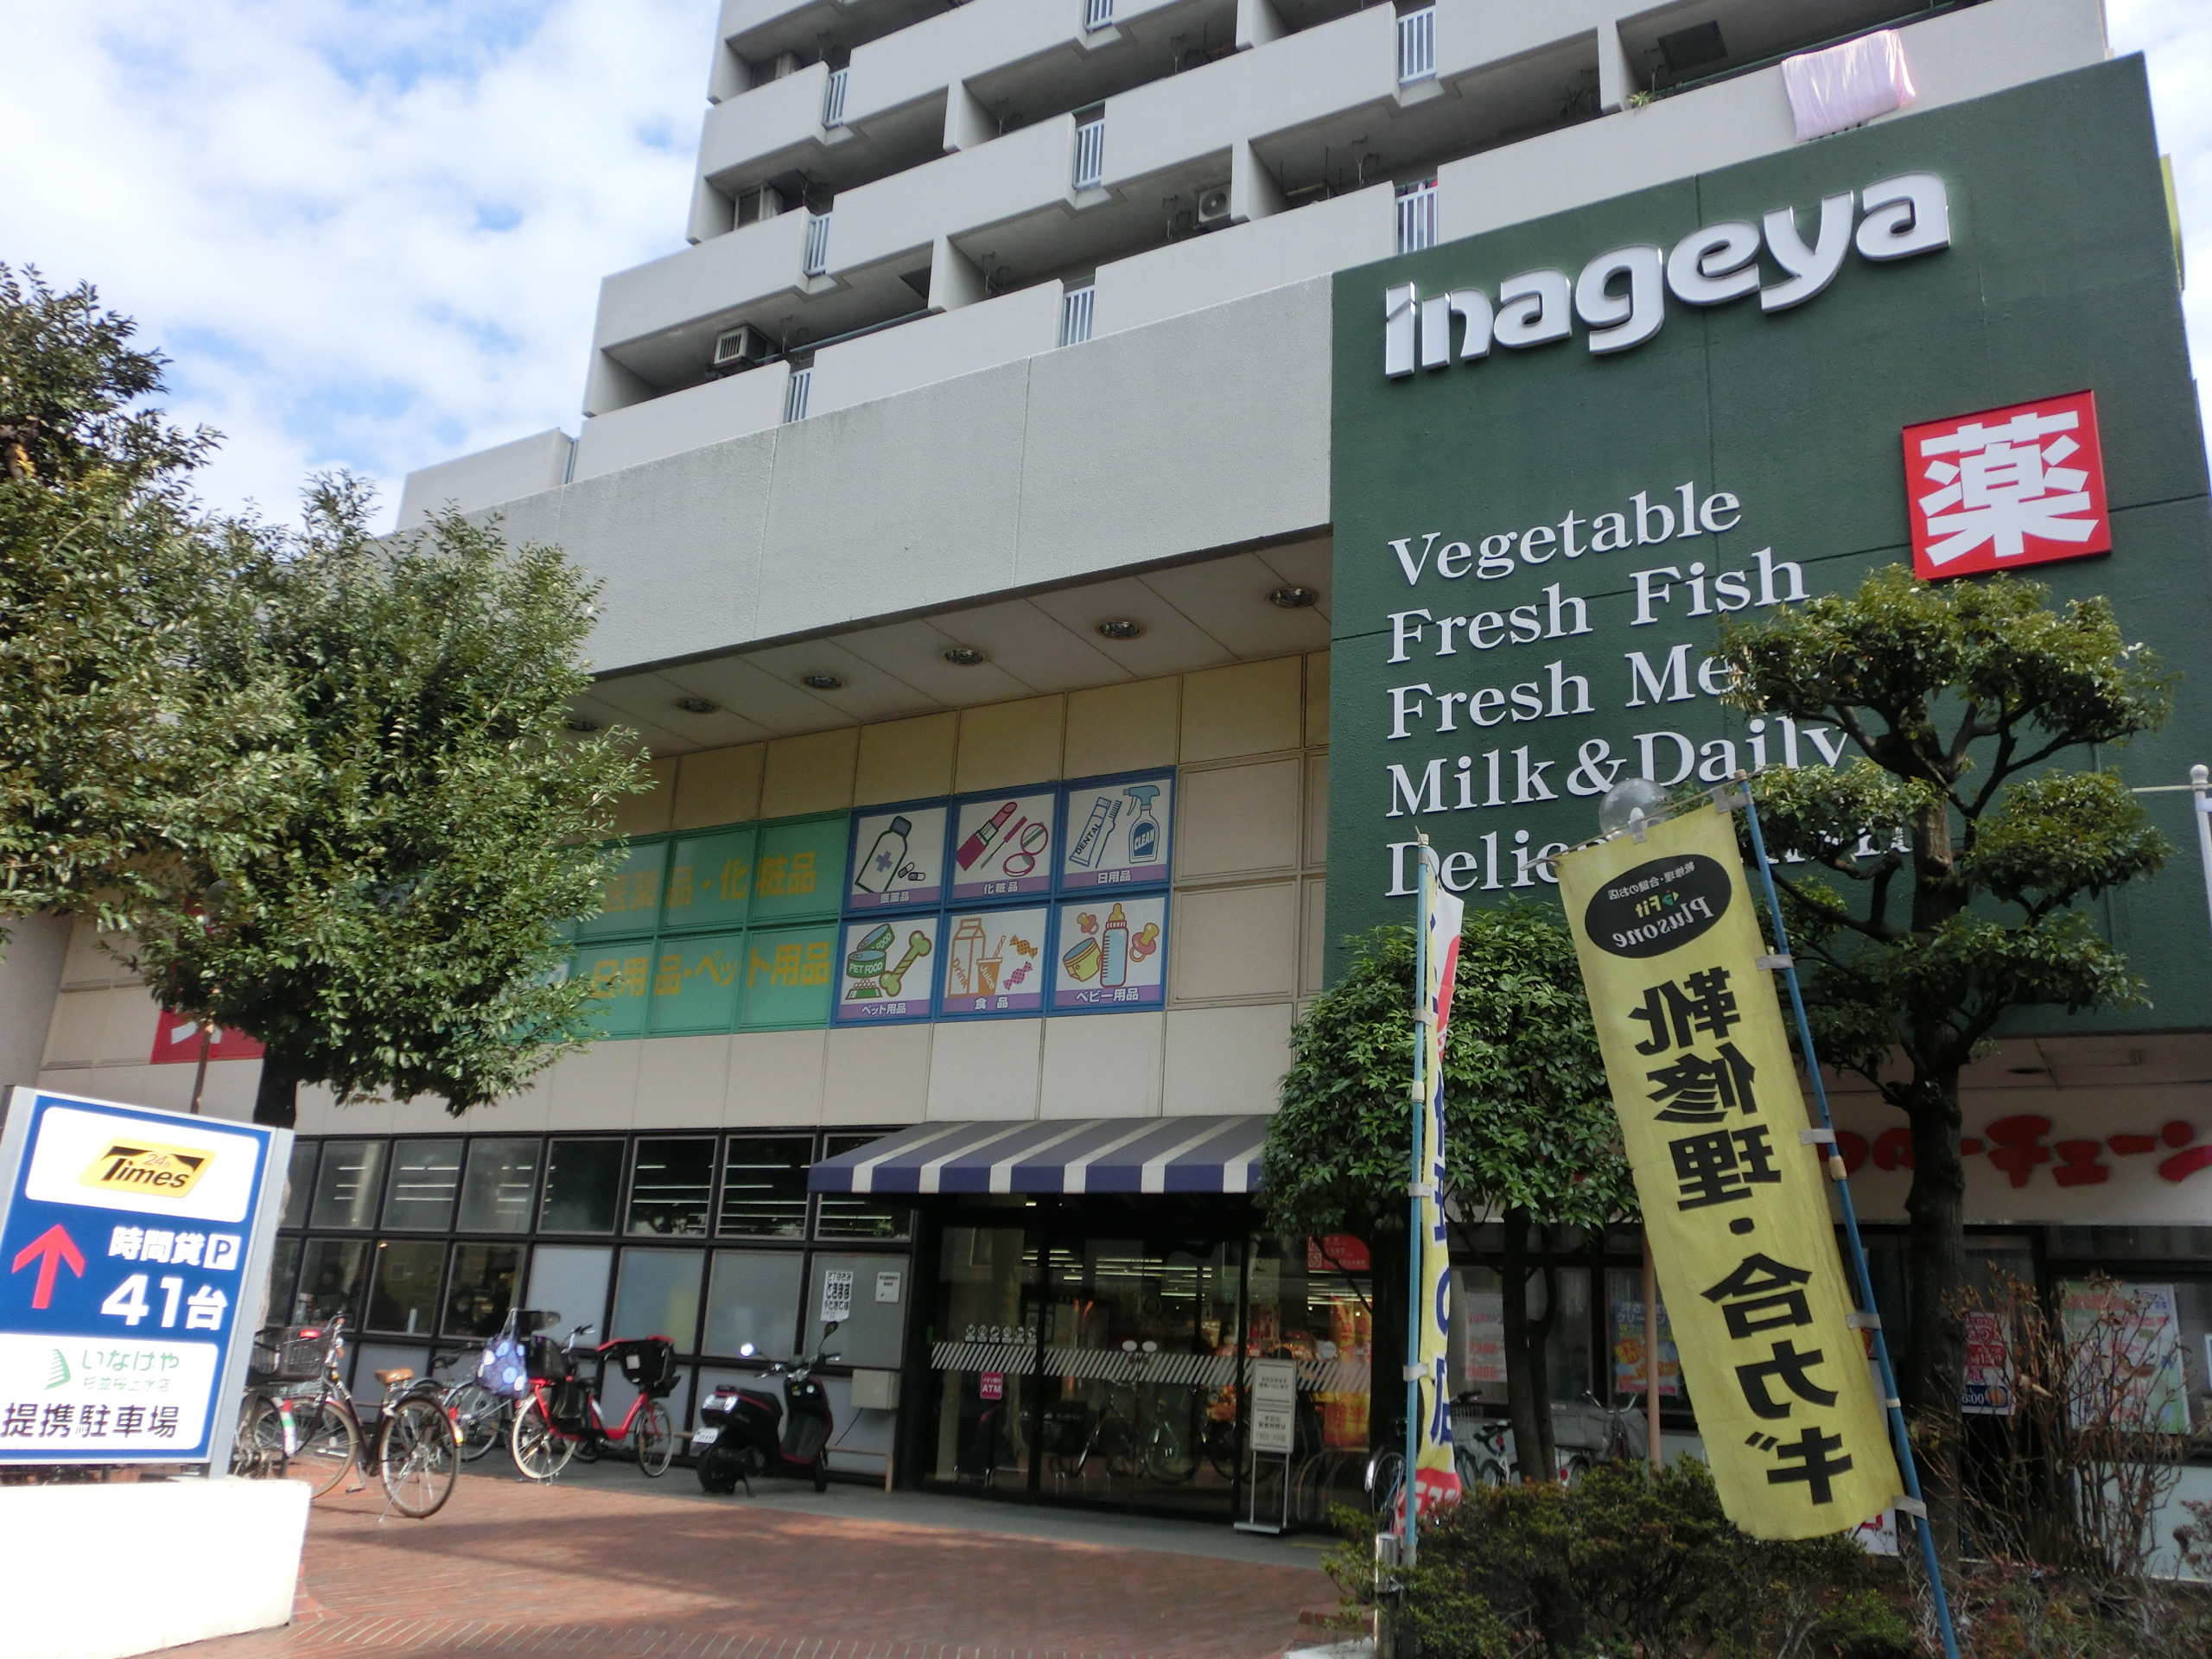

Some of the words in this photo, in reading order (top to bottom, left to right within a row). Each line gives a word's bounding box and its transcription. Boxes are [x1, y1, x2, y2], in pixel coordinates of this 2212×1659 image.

[1384, 172, 1952, 378] inageya
[1918, 410, 2100, 569] 薬
[1387, 480, 1742, 587] Vegetable
[1386, 582, 1593, 664] Fresh
[1630, 546, 1810, 628] Fish
[1386, 660, 1595, 741] Fresh
[1624, 644, 1740, 709] Me
[1075, 823, 1102, 855] DENTAL
[1134, 829, 1155, 851] CLEAN
[983, 881, 1019, 895] 化粧品
[1096, 869, 1131, 885] 日用品
[880, 891, 910, 905] 医薬品
[875, 932, 892, 949] FOOD
[849, 963, 864, 974] PET
[864, 962, 883, 974] FOOD
[952, 957, 969, 988] Drink
[980, 966, 995, 989] Juice
[1076, 987, 1140, 1003] ベビー用品
[861, 1002, 907, 1016] ペット用品
[100, 1158, 190, 1189] Times
[101, 1273, 229, 1331] 41台
[982, 1384, 1002, 1394] ATM
[0, 1402, 180, 1439] 提携駐車場
